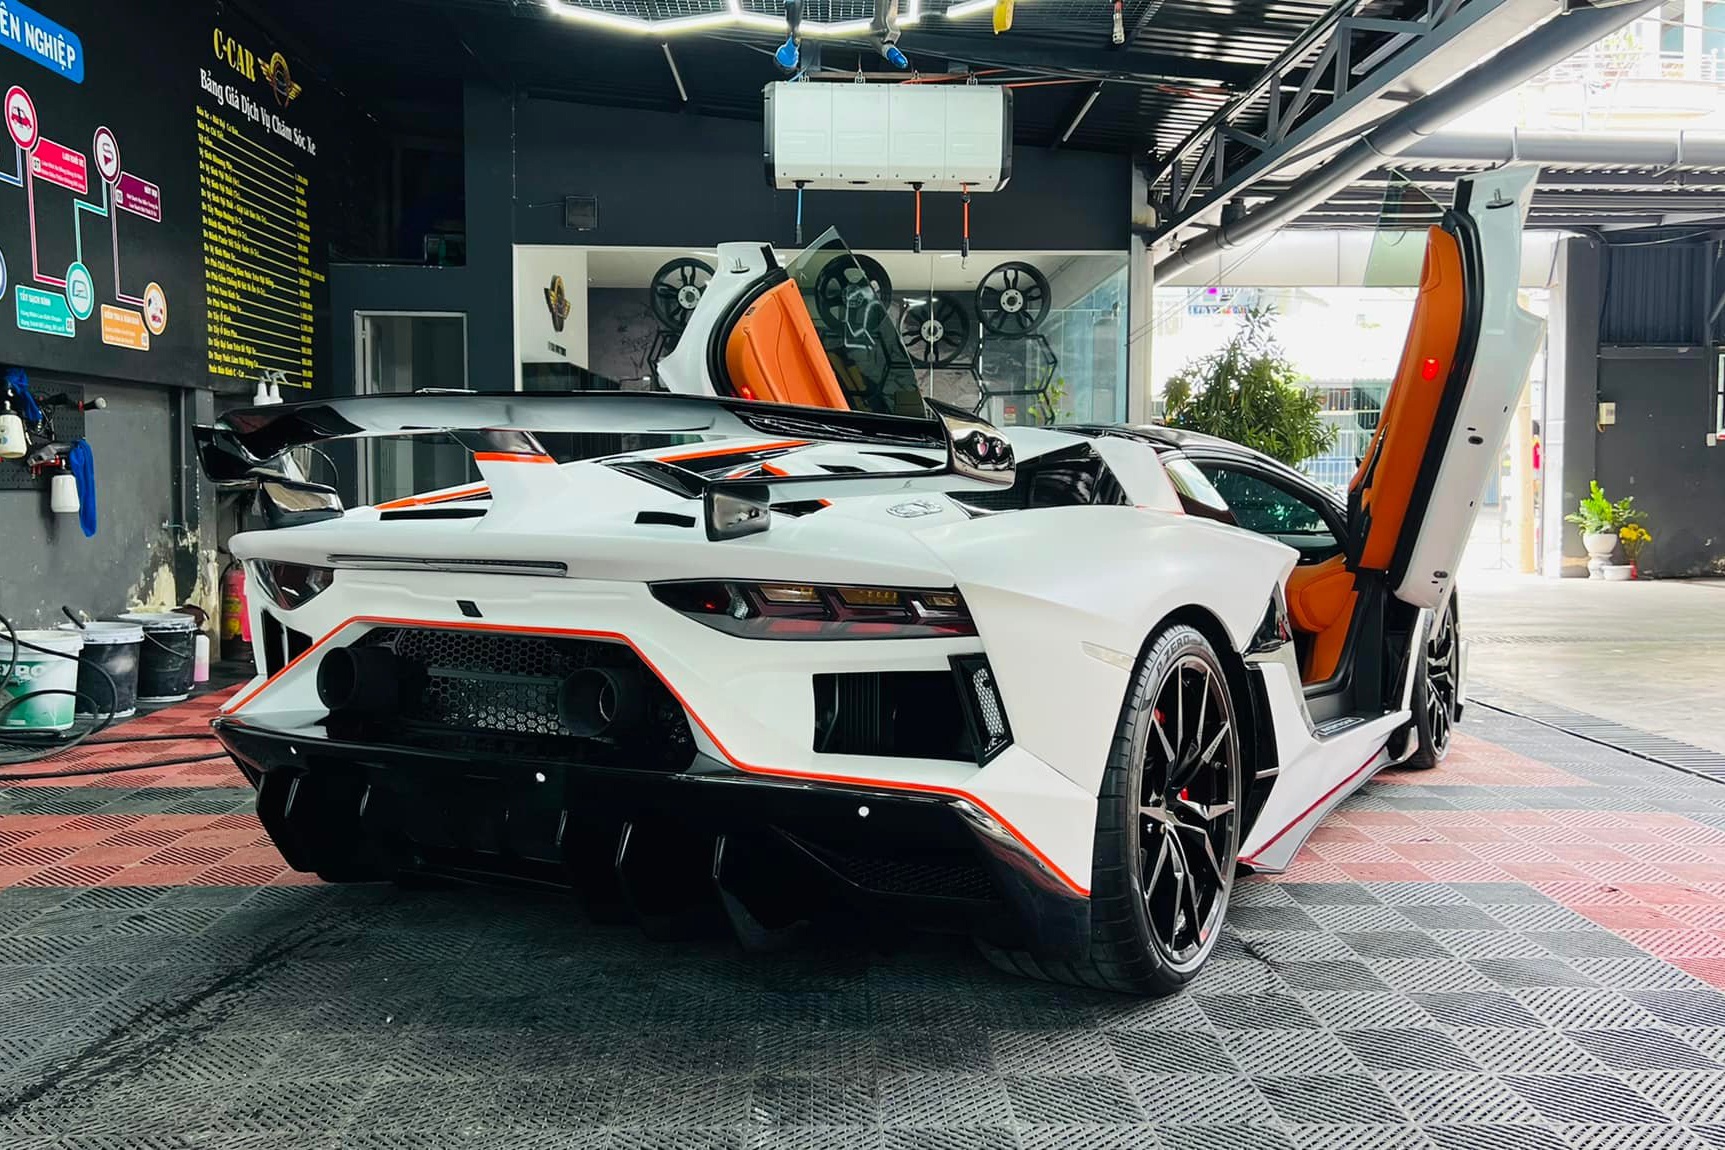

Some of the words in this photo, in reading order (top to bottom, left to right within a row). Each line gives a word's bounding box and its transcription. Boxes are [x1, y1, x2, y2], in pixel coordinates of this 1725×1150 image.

[24, 21, 76, 71] NGHIỆP
[213, 28, 256, 82] C-CAR
[200, 67, 224, 105] Bảng
[225, 85, 240, 110] Giá
[241, 94, 260, 122] Dịch
[260, 106, 271, 133] Vụ
[306, 135, 316, 156] Xe
[1164, 635, 1190, 662] ZERO
